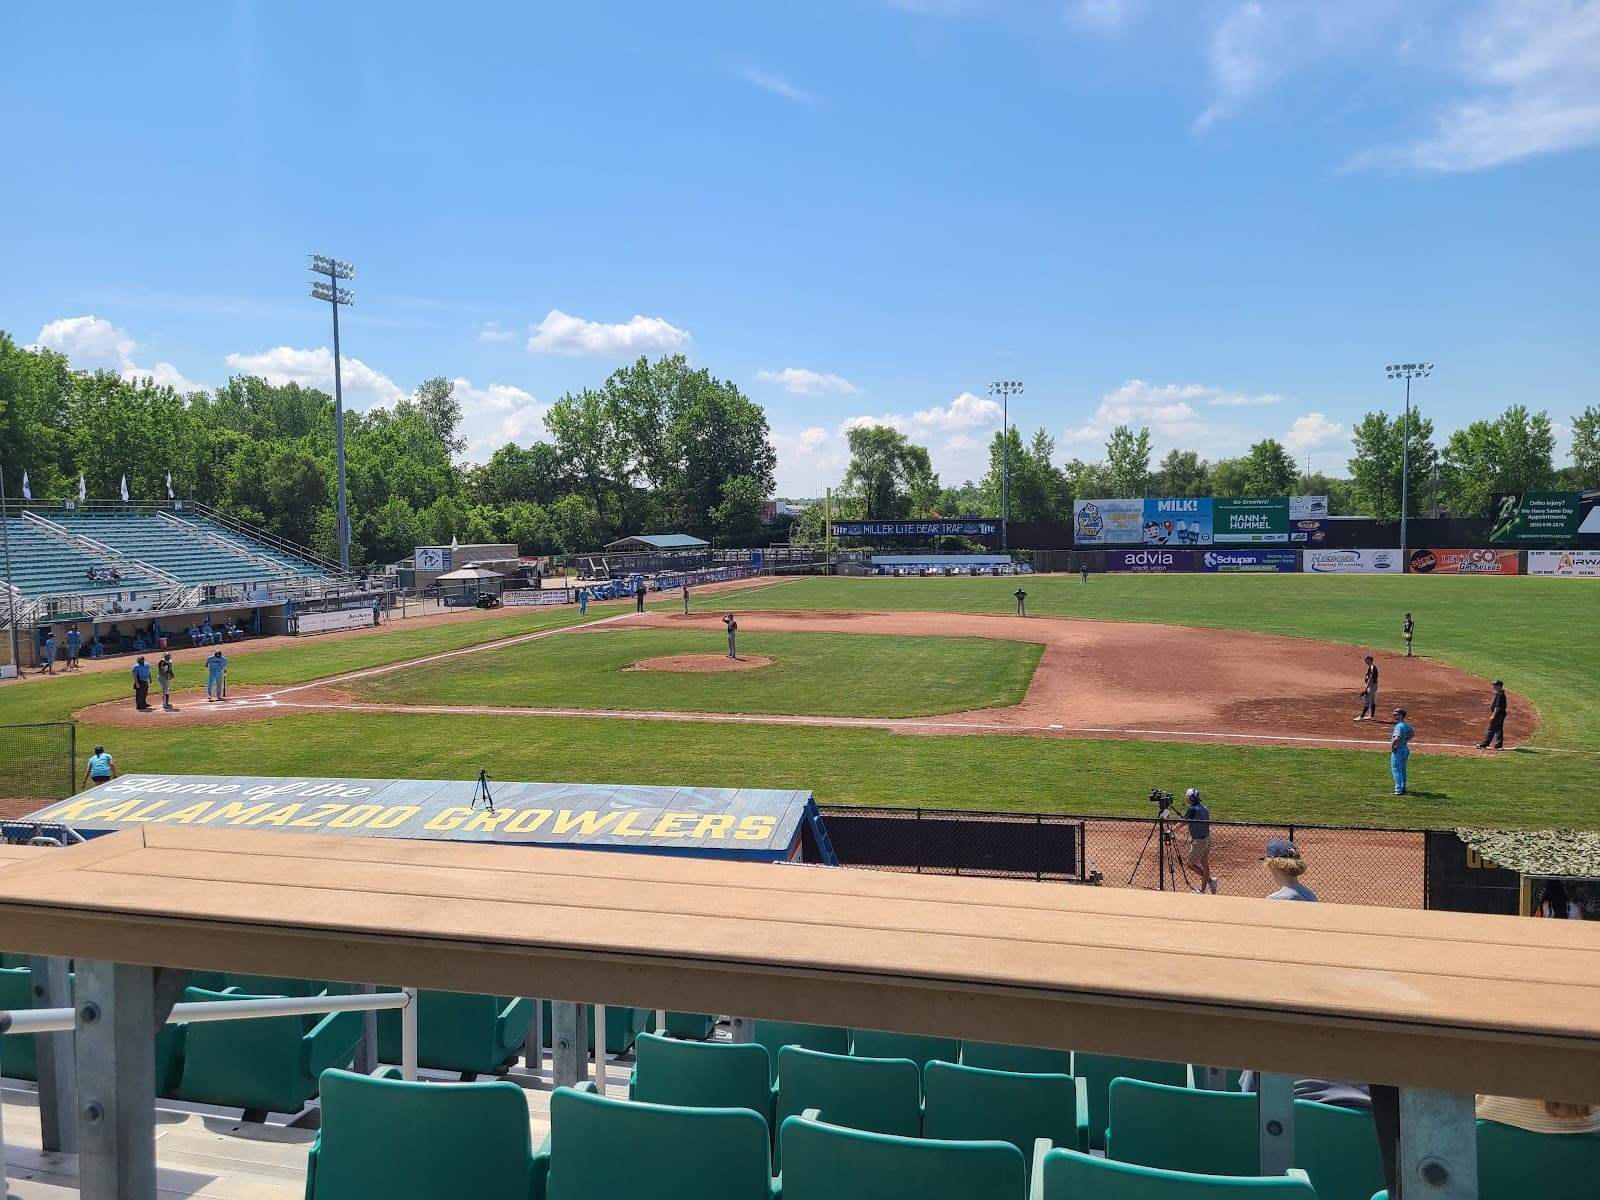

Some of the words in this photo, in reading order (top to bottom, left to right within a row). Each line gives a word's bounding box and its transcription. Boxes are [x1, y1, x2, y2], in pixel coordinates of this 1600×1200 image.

[1158, 500, 1198, 512] MILK!
[832, 524, 848, 535] Lite
[916, 523, 940, 534] BEAR
[942, 523, 963, 533] TRAP
[978, 523, 995, 533] Lite
[1230, 521, 1271, 529] HUMMEL
[1124, 551, 1173, 565] advia
[1217, 555, 1256, 566] Schupan
[1469, 549, 1497, 564] GO
[104, 779, 241, 795] Home
[242, 782, 308, 801] of
[297, 782, 371, 798] the
[42, 798, 421, 829] KALAMAZOO
[423, 806, 777, 840] GROWLERS
